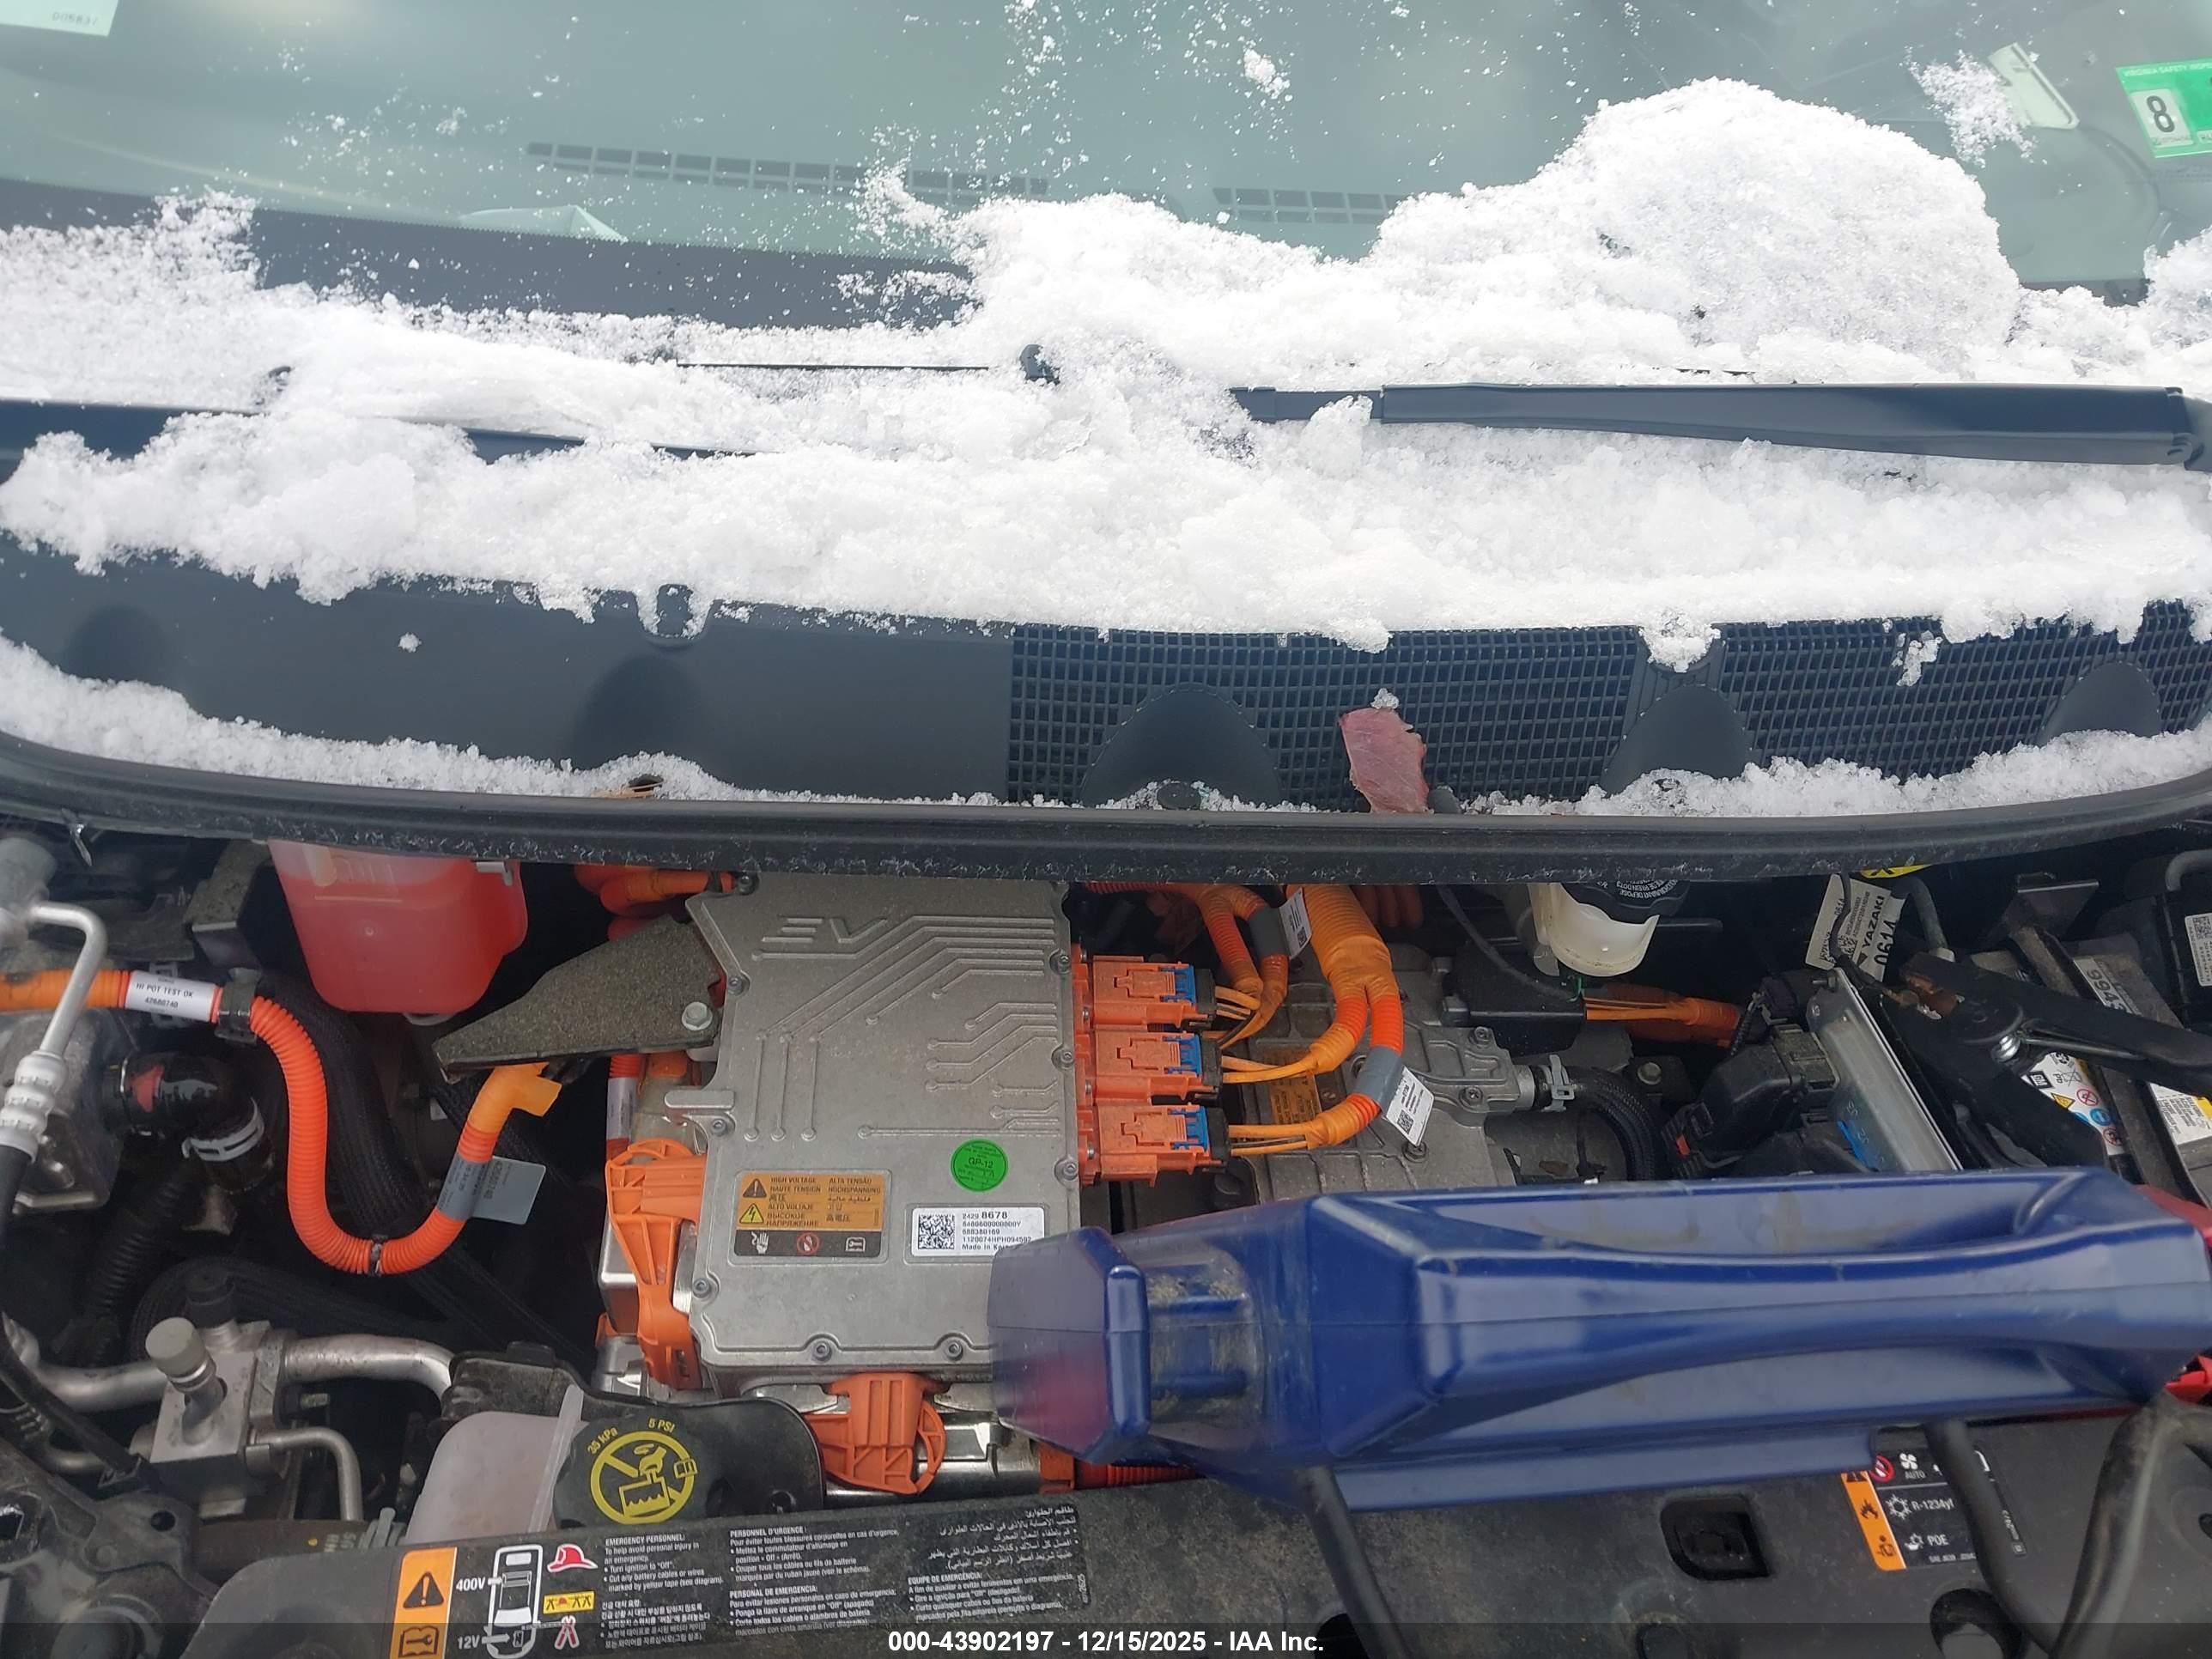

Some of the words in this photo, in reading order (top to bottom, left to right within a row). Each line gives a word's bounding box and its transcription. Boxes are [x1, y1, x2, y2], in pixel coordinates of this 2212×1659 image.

[2146, 94, 2175, 133] 8
[1862, 896, 1886, 949] YAZAKI
[146, 984, 161, 994] POT
[163, 988, 181, 996] TEST
[969, 1157, 994, 1169] GP-12
[981, 1211, 1008, 1219] 8678
[648, 1418, 656, 1428] 5
[658, 1419, 676, 1433] PSI
[599, 1426, 619, 1444] kPa
[1905, 1470, 1926, 1480] AUTO
[1911, 1498, 1955, 1511] R-1234yf
[1927, 1534, 1949, 1546] POE
[456, 1578, 486, 1592] 400V
[457, 1635, 480, 1650] 12V
